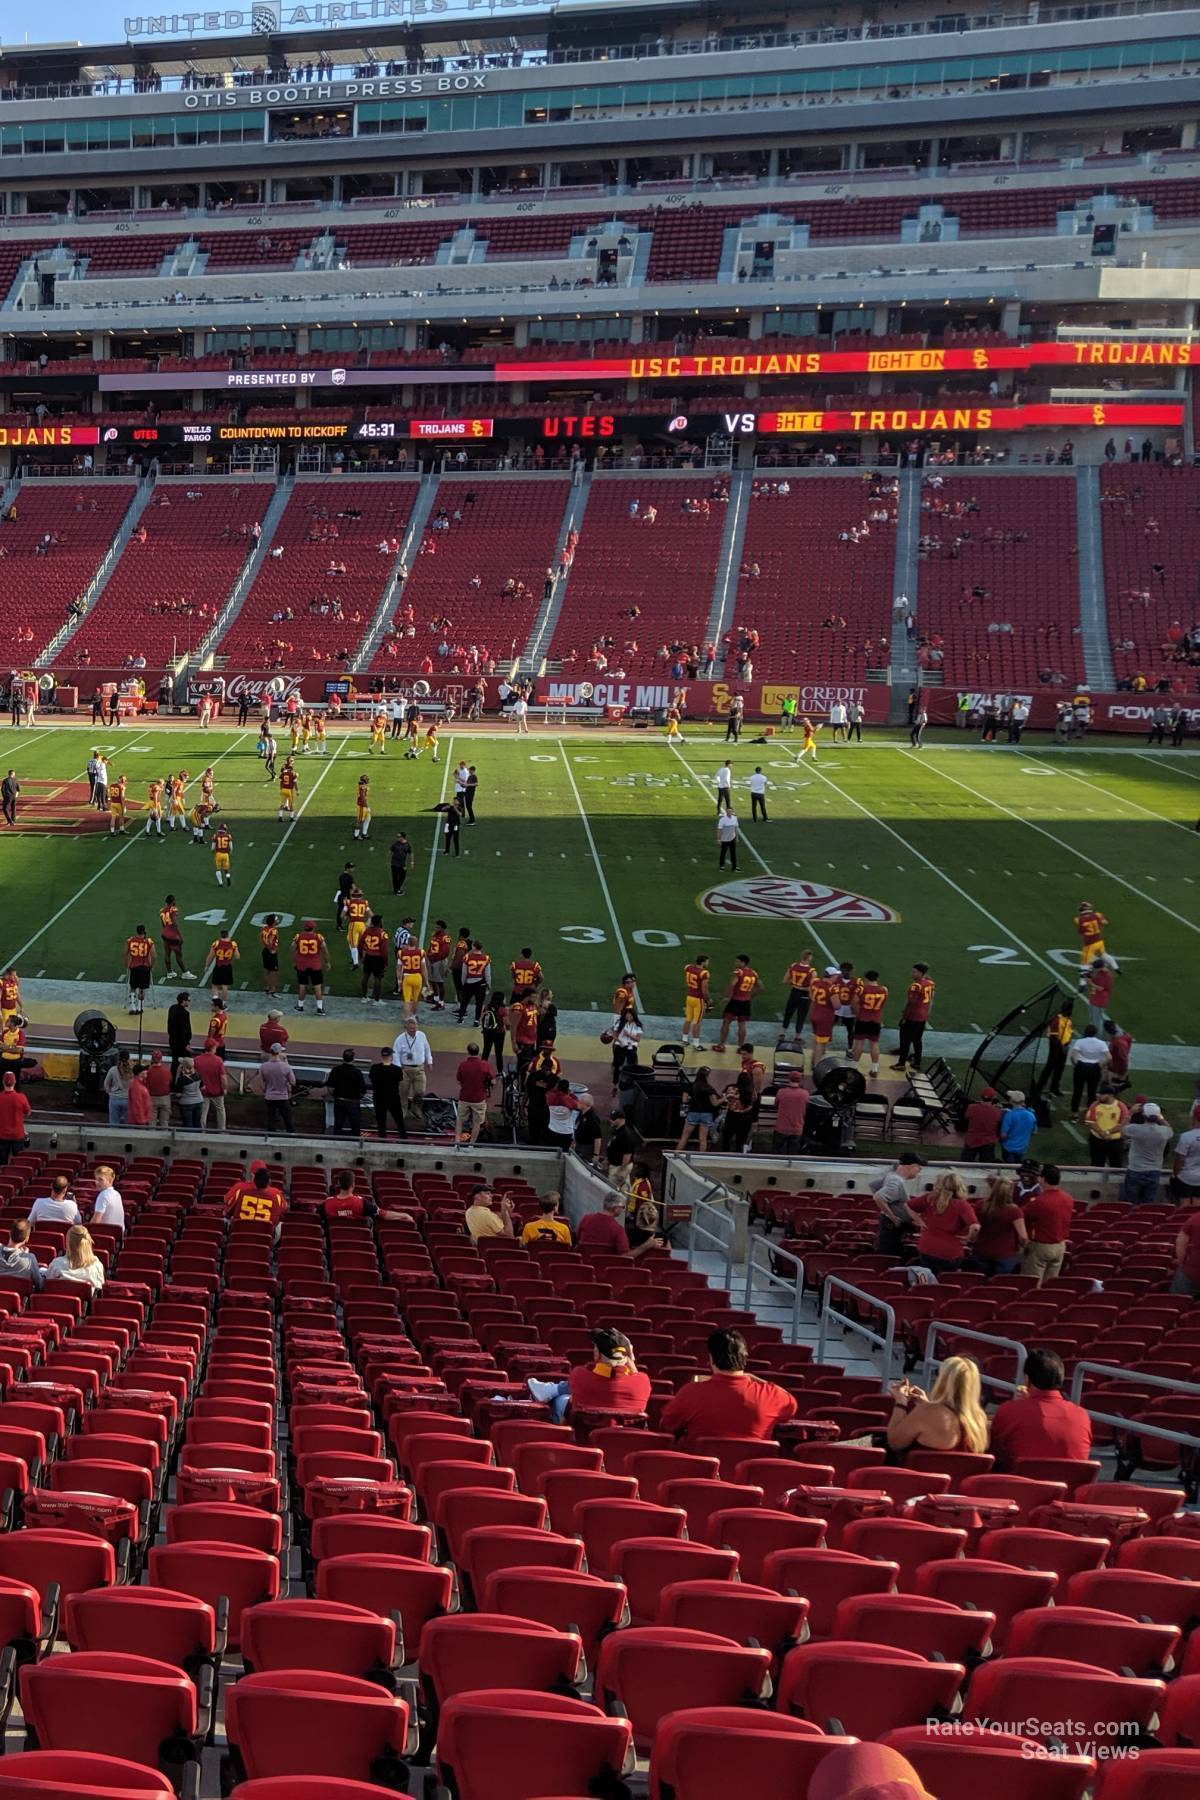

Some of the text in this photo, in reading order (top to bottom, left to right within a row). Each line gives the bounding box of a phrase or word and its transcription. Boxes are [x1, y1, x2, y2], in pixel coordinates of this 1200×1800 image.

[125, 0, 448, 36] UNITED AIRLINES
[185, 75, 486, 108] OTIS BOOTH PRESS BOX
[247, 217, 261, 225] 406
[384, 210, 399, 218] 407
[115, 223, 129, 231] 405
[869, 352, 914, 369] IGHT
[1075, 343, 1191, 364] TROJANS
[631, 354, 821, 378] USC TROJANS
[228, 373, 316, 386] PRESENTED BY
[544, 415, 614, 437] UTES
[725, 414, 755, 432] VS
[851, 410, 992, 430] TROJANS
[134, 430, 158, 440] UTES
[183, 426, 211, 434] WELLS
[220, 426, 347, 439] COUNTDOWN TO KICKOFF
[359, 423, 395, 437] 45:31
[419, 424, 465, 434] TROJANS
[184, 434, 211, 442] FARGO
[226, 673, 305, 703] Coca-ola
[549, 683, 630, 708] MUCLE
[802, 687, 868, 701] CREDIT
[611, 709, 621, 717] G
[217, 836, 228, 848] 16
[350, 903, 365, 917] 30
[184, 908, 296, 928] 40
[1084, 921, 1101, 935] 31
[559, 925, 681, 947] 30
[300, 939, 318, 954] 63
[216, 948, 233, 961] 44
[402, 955, 421, 970] 38
[468, 960, 487, 975] 27
[515, 969, 534, 984] 36
[686, 972, 698, 989] 15
[790, 972, 808, 987] 17
[812, 986, 826, 1005] 72
[863, 992, 885, 1010] 97
[239, 1194, 273, 1222] 55
